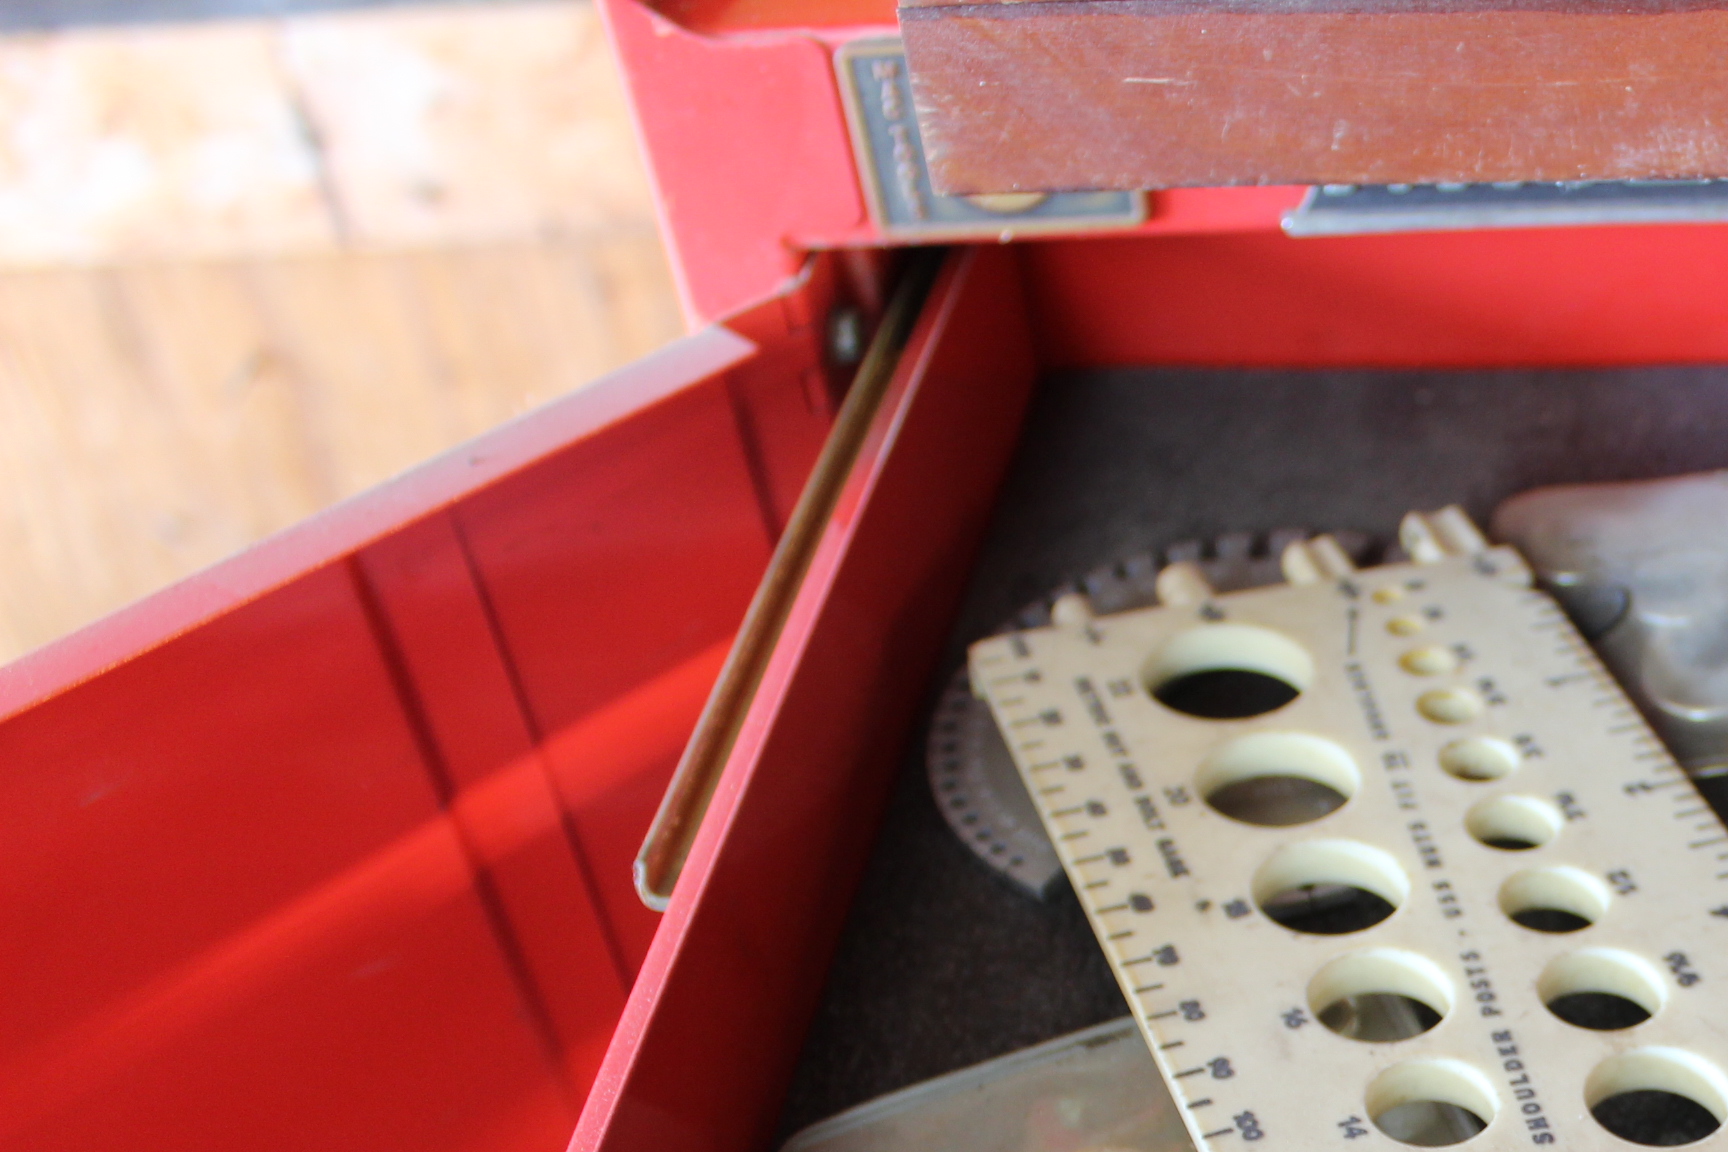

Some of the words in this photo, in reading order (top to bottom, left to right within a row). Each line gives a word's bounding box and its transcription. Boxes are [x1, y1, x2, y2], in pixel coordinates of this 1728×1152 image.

[1409, 822, 1443, 869] NUTS
[1433, 881, 1462, 919] USS
[1460, 951, 1502, 1017] POSTS
[1179, 1000, 1206, 1022] 80
[1281, 1008, 1308, 1029] 16
[1207, 1057, 1235, 1080] 90
[1491, 1030, 1555, 1145] SHOULDER
[1233, 1110, 1265, 1141] 100
[1338, 1116, 1368, 1139] 14
